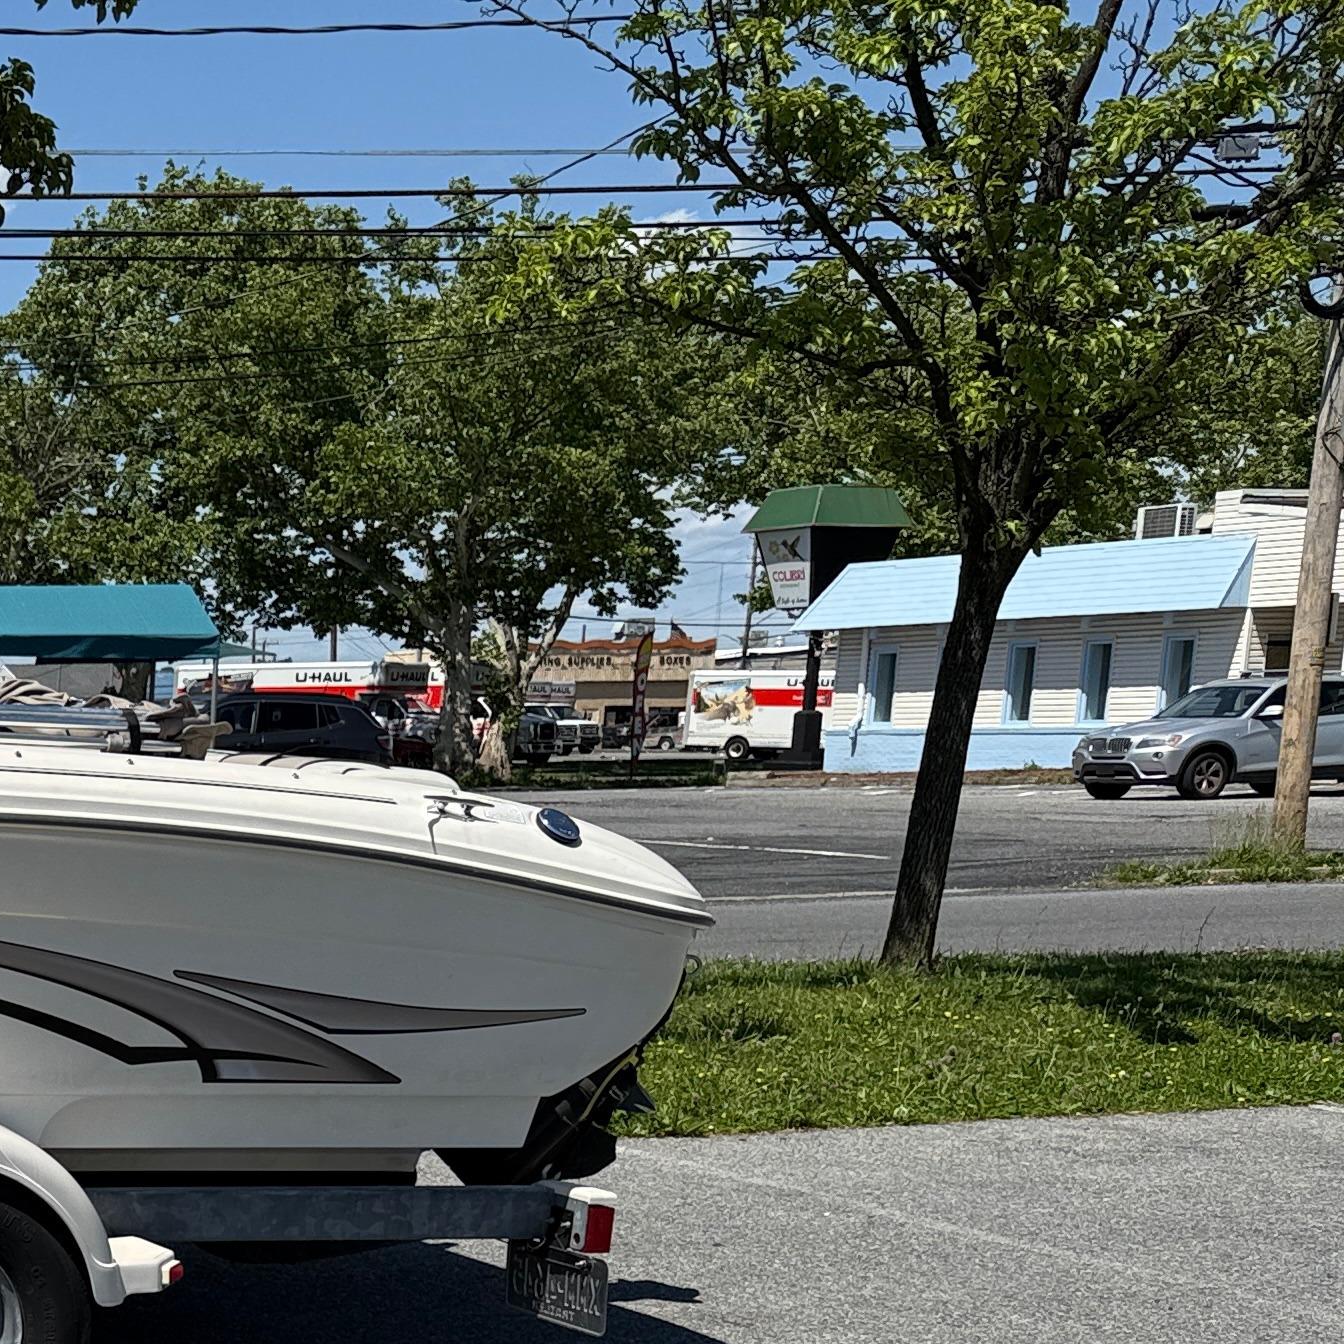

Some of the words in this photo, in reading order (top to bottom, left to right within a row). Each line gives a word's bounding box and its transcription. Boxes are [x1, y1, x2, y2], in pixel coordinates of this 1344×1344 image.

[541, 656, 561, 667] ING
[568, 656, 612, 667] SUPPLIES
[659, 655, 691, 666] BOXES
[295, 672, 352, 683] U-HAUL
